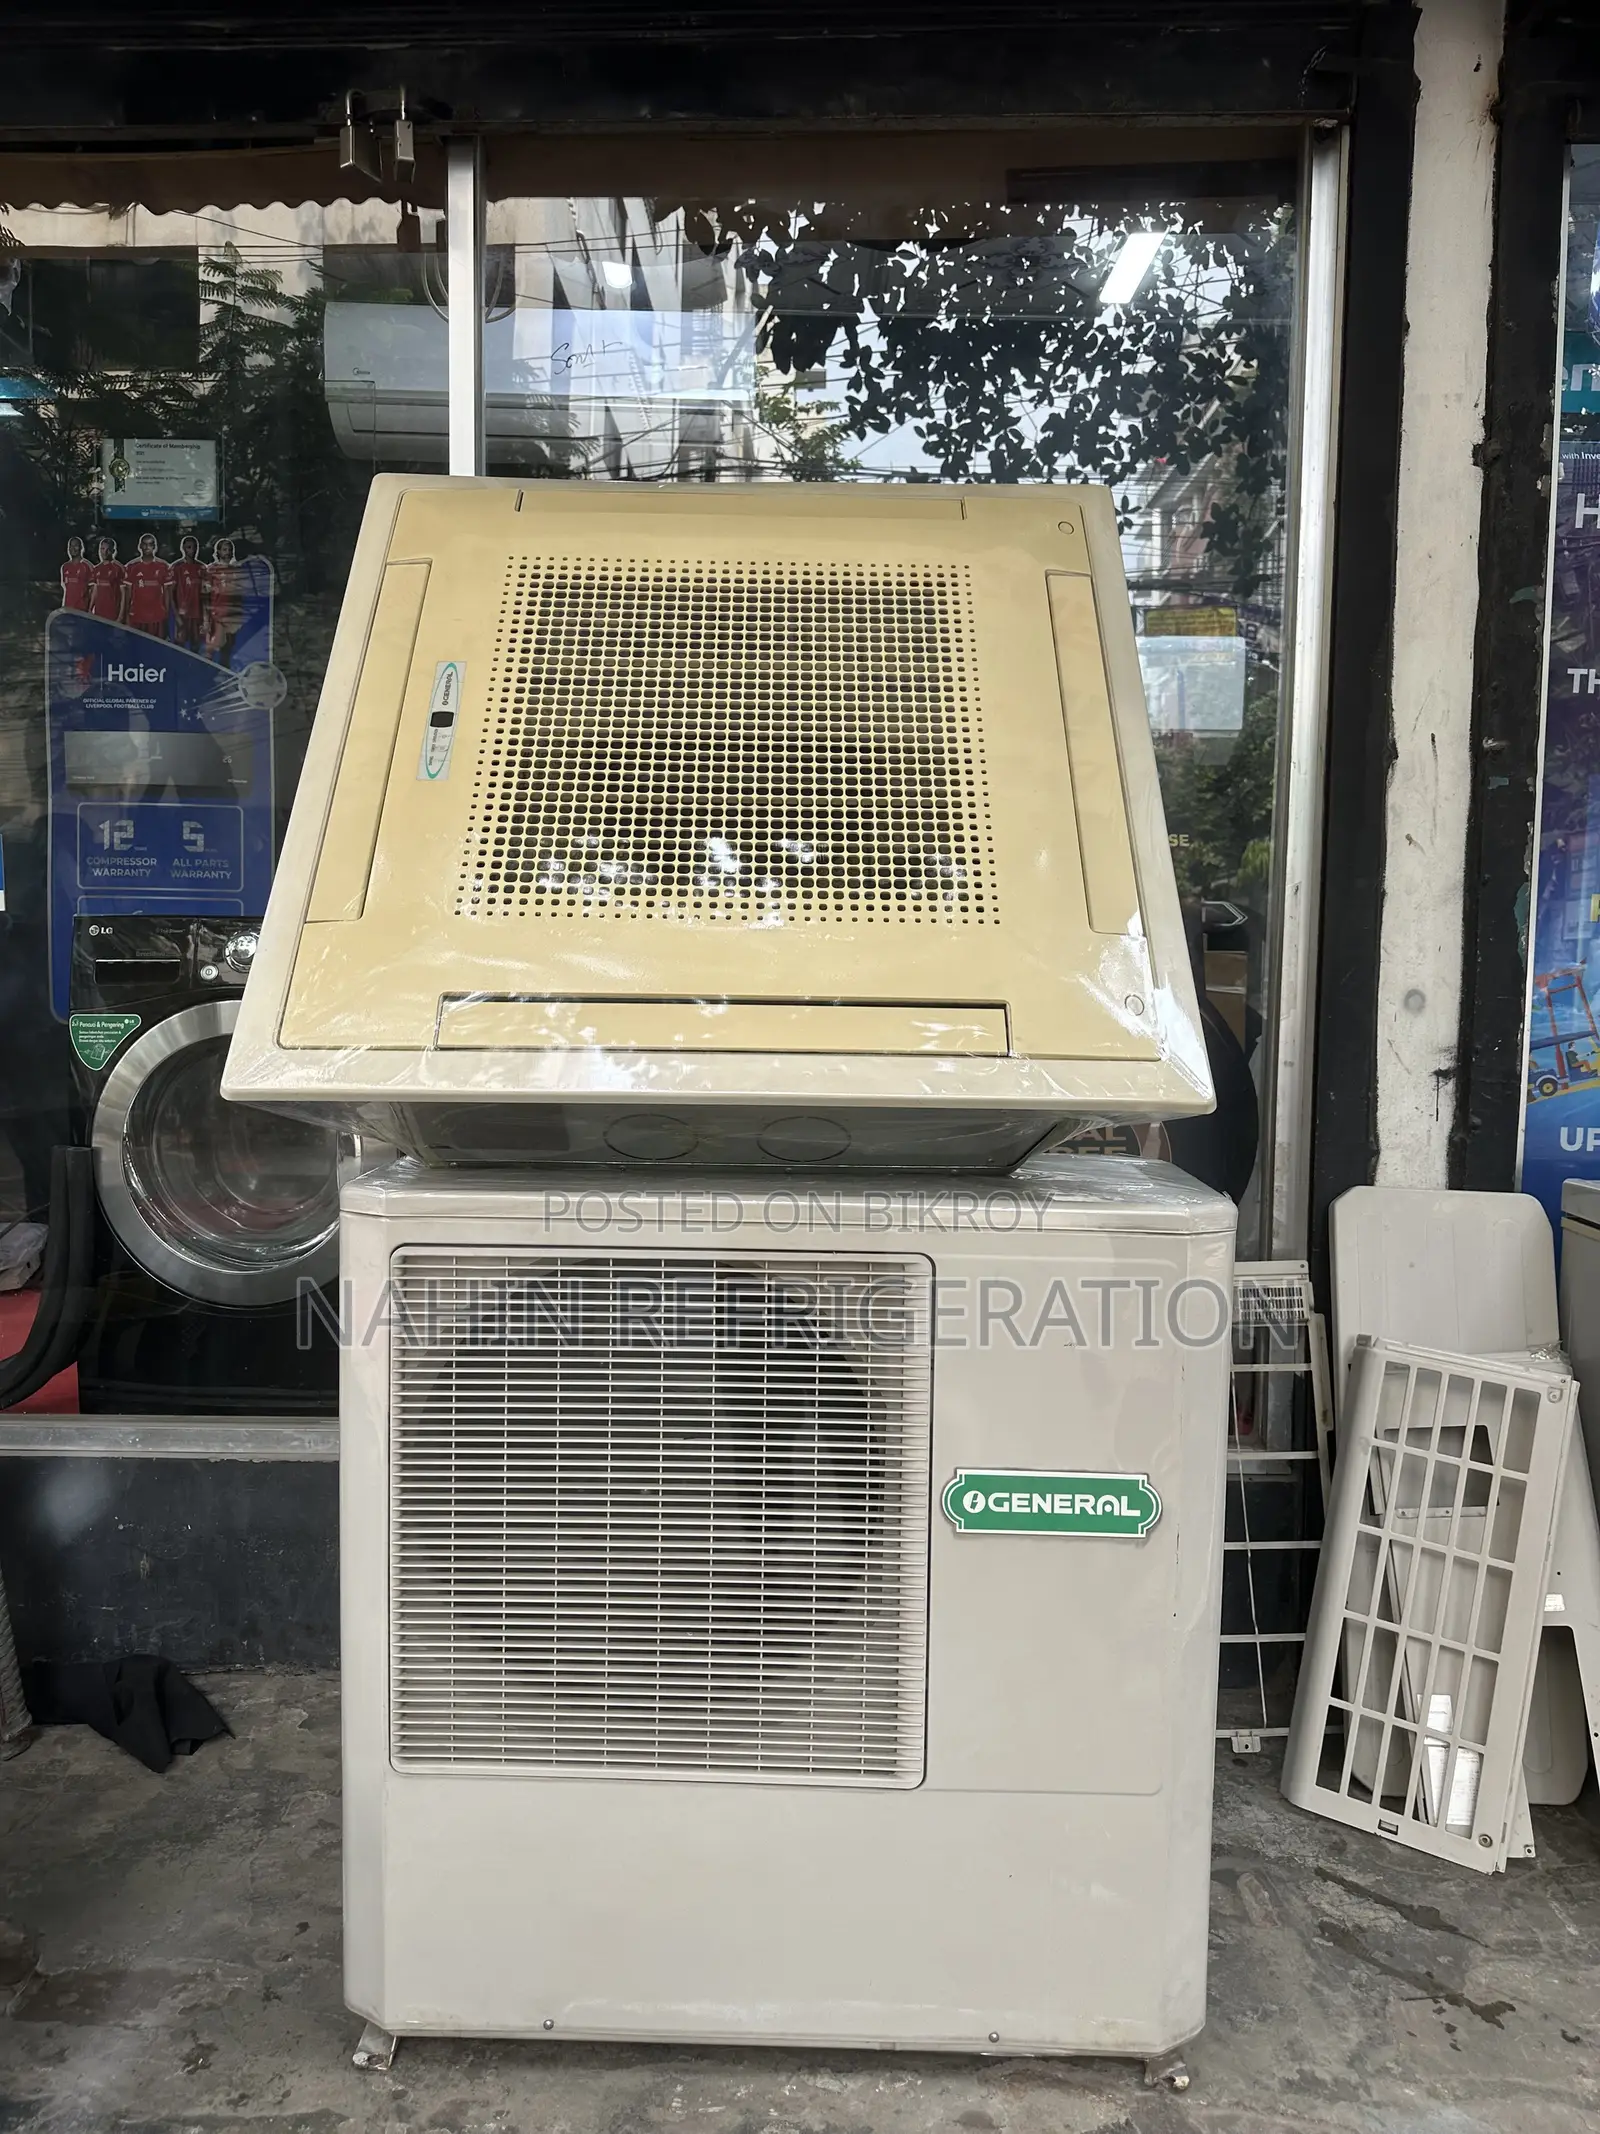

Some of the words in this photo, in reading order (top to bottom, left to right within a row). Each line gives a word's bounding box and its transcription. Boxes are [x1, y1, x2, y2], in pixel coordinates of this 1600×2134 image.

[1562, 452, 1579, 460] with
[107, 663, 167, 682] Haier
[99, 819, 134, 851] 12
[182, 820, 205, 853] 5
[86, 856, 158, 867] COMPRESSOR
[172, 858, 193, 867] ALL
[194, 859, 229, 869] PARTS
[92, 868, 152, 878] WARRANTY
[170, 870, 233, 880] WARRANTY
[100, 927, 113, 935] LG
[988, 1492, 1141, 1517] GENERAL
